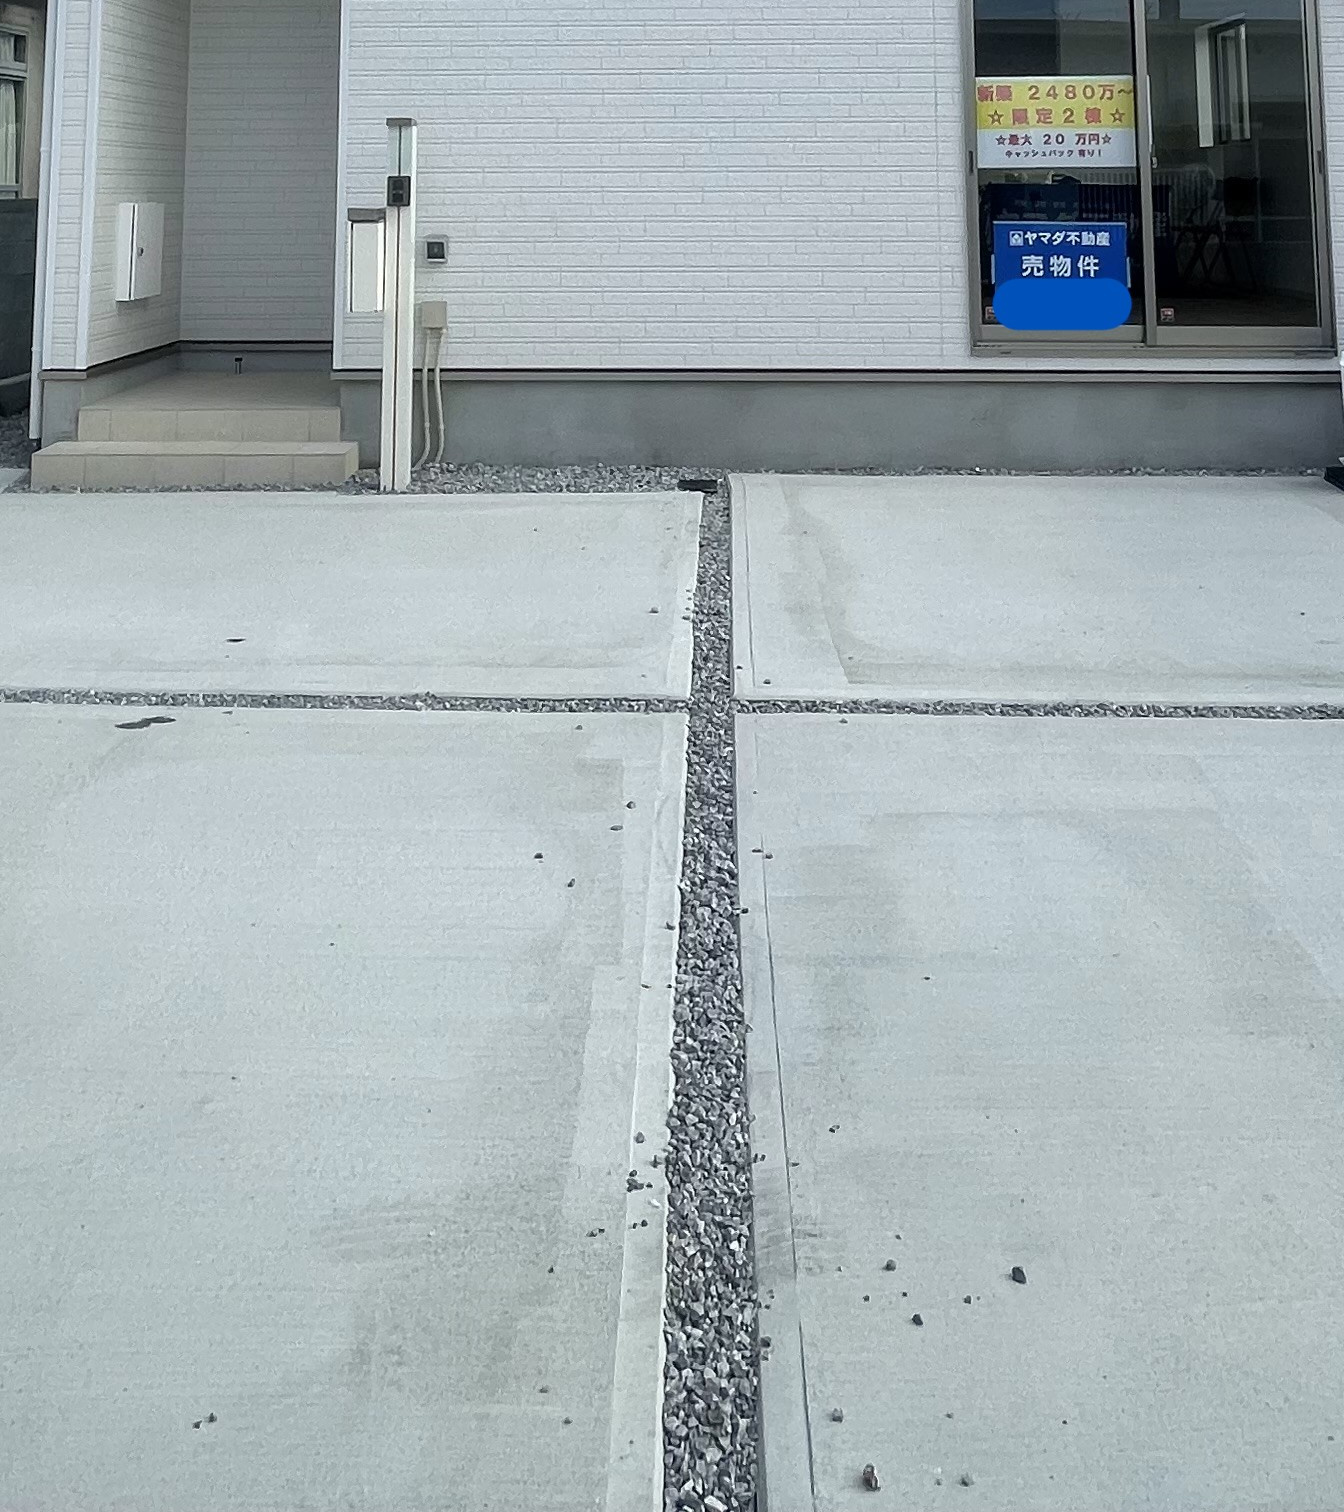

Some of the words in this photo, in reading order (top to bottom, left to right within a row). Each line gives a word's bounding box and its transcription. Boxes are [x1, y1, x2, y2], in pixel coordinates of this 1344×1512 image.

[1025, 231, 1111, 246] ヤマダ不動産
[1021, 255, 1100, 278] 売物件
